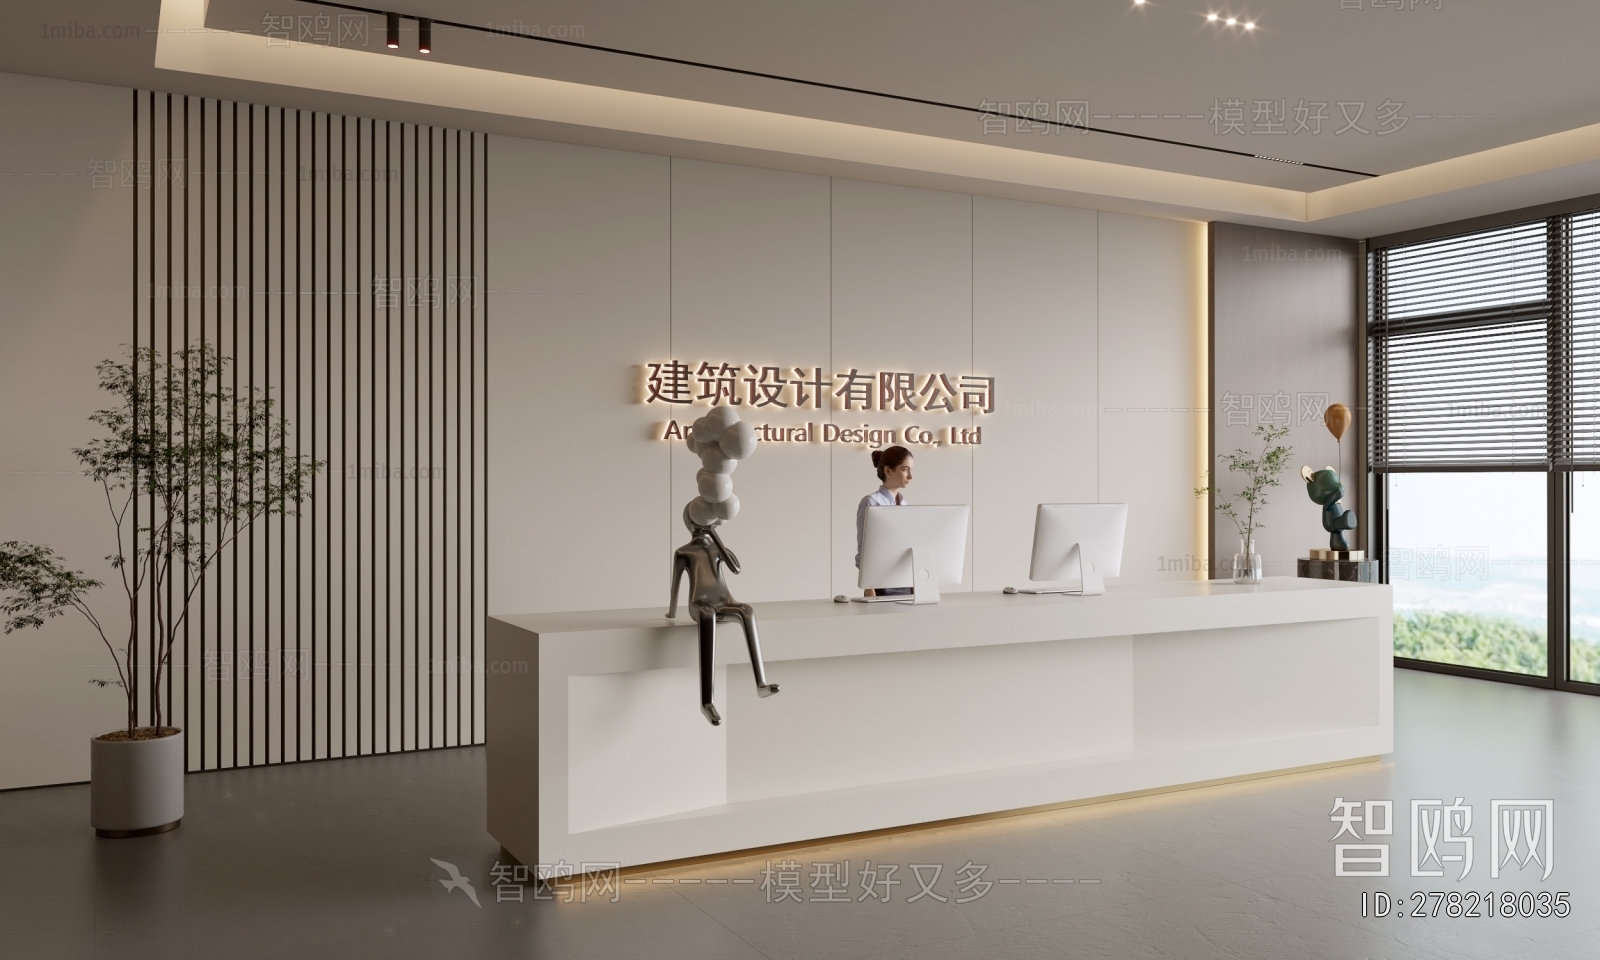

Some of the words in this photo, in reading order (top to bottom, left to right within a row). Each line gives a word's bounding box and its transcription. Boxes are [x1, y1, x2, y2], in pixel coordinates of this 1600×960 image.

[645, 360, 995, 415] 建筑设计有限公司
[662, 419, 813, 442] Artural
[823, 423, 896, 449] Design
[950, 426, 981, 445] Ltd
